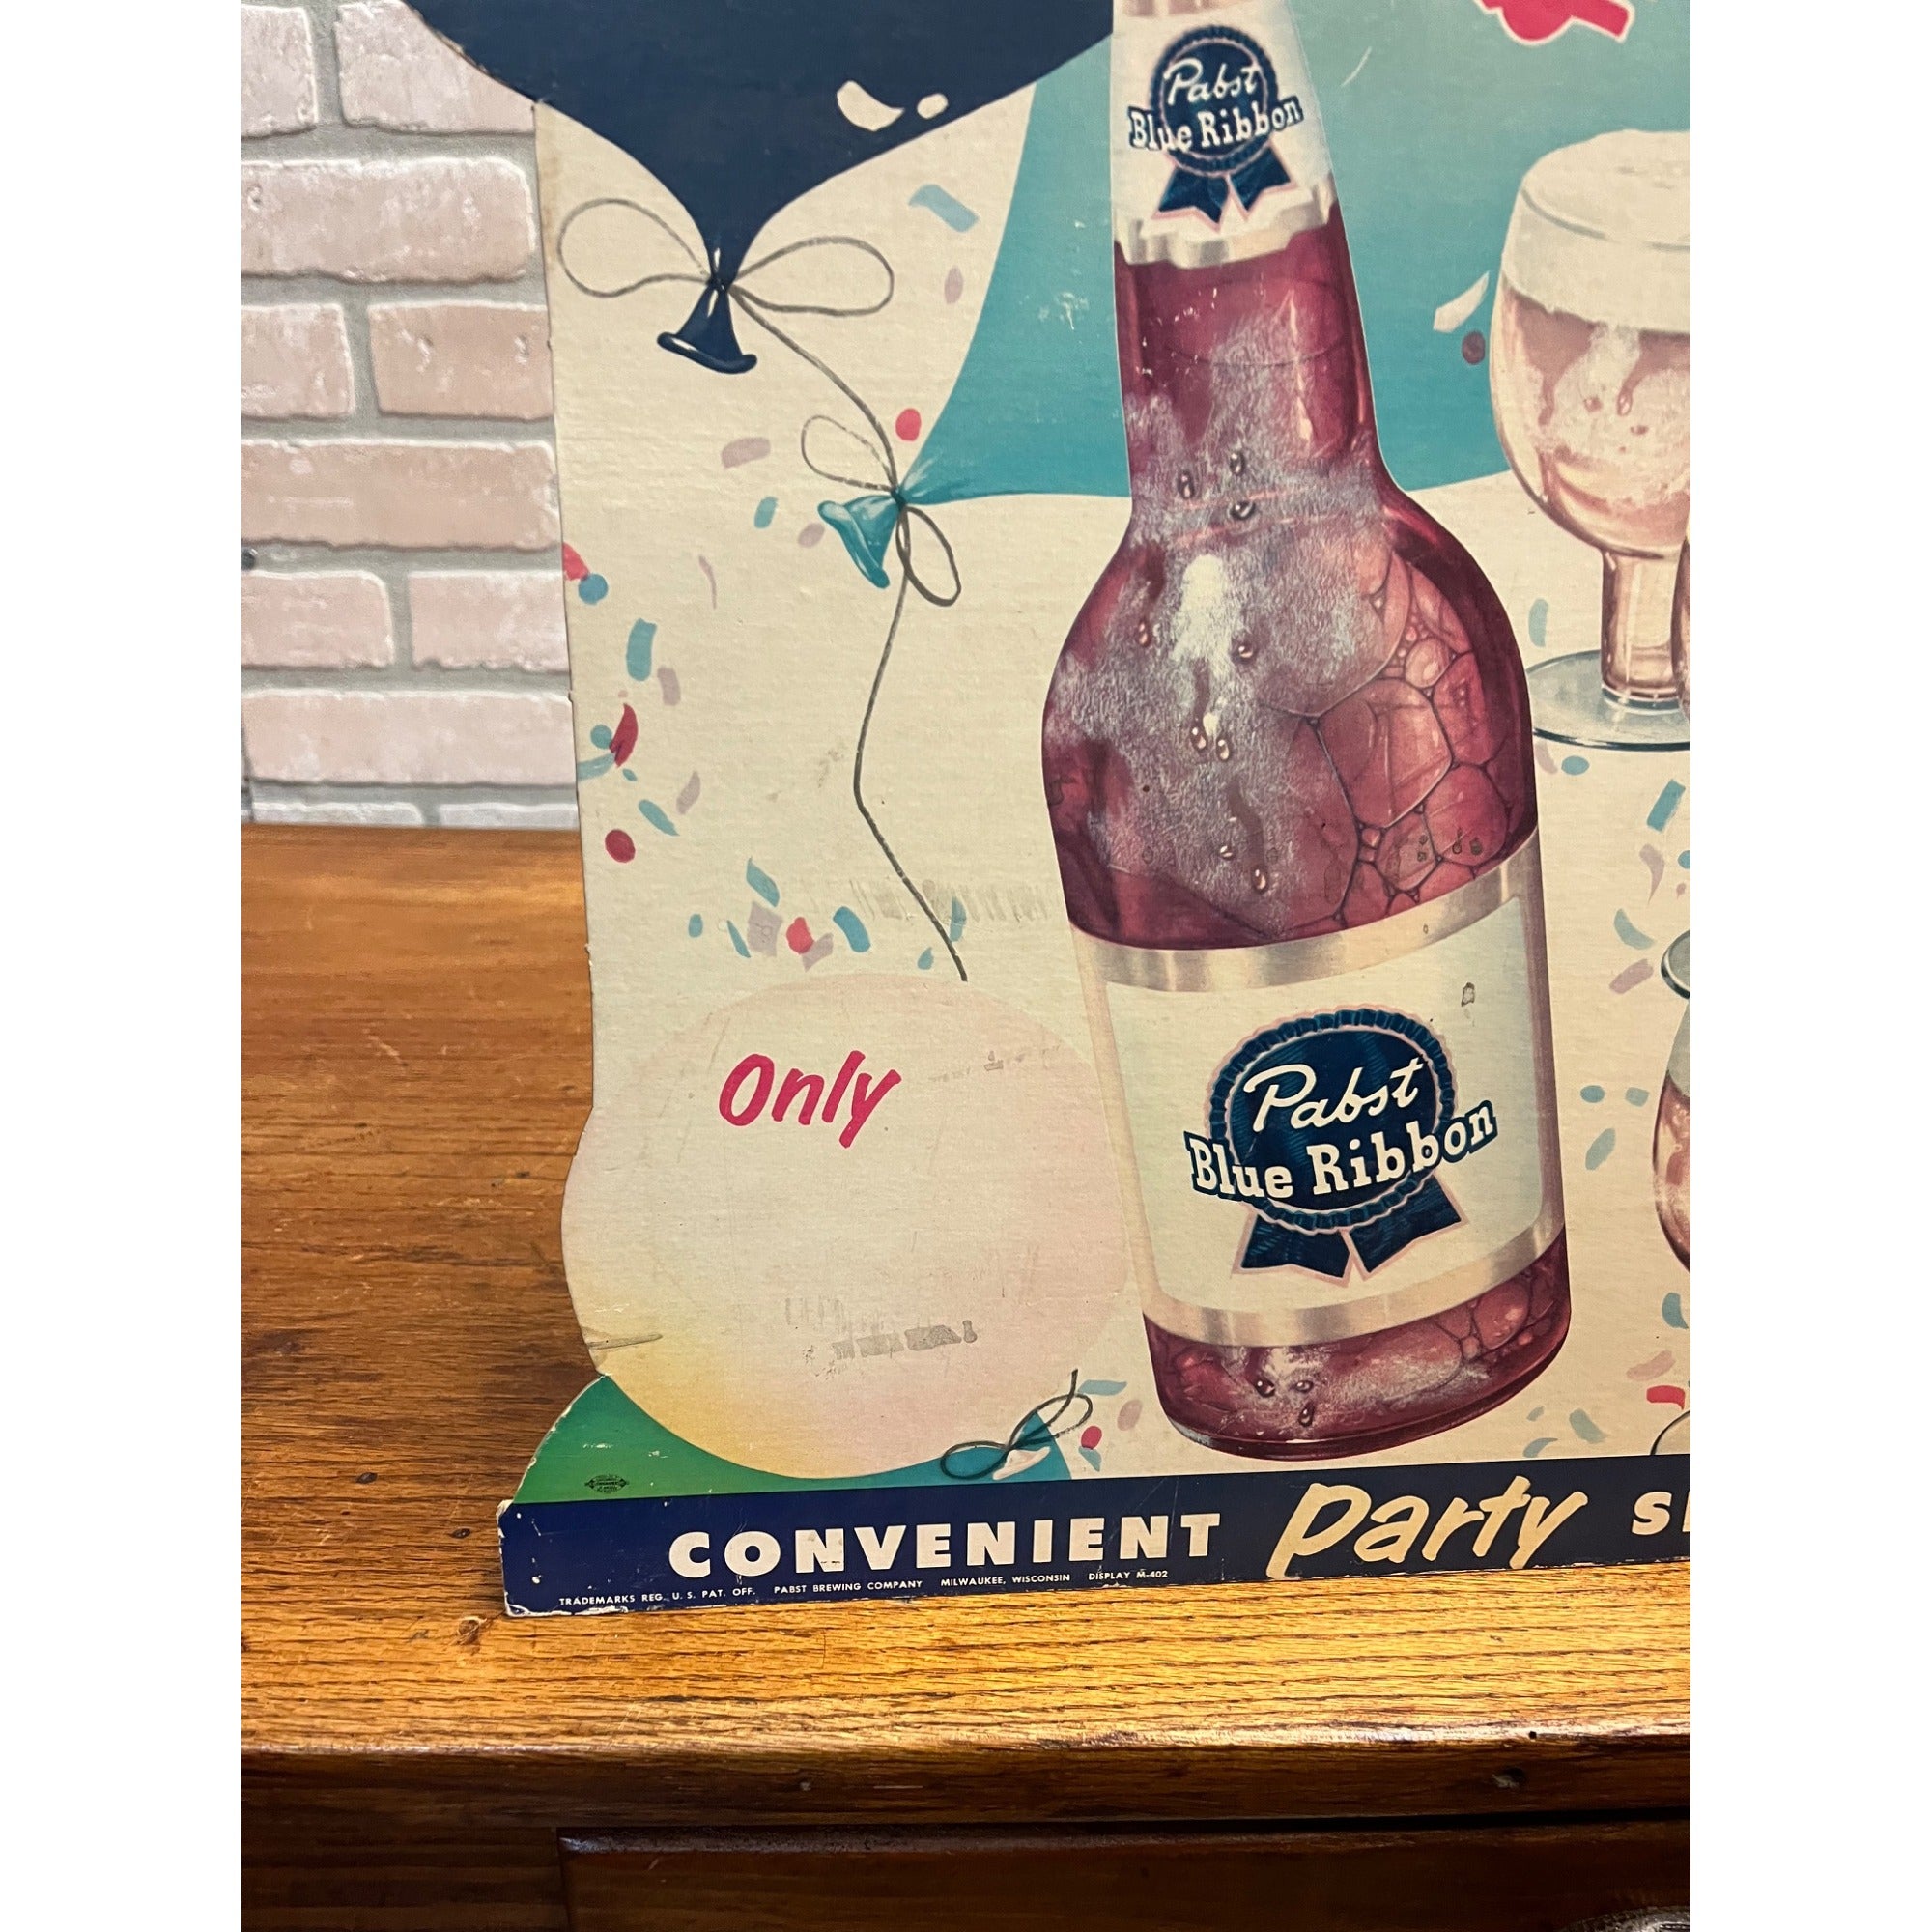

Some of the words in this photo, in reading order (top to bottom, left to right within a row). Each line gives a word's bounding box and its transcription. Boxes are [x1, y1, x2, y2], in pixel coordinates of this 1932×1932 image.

[1163, 57, 1261, 106] Pabst
[1130, 111, 1192, 153] Blue
[1197, 99, 1301, 148] Ribbon
[719, 1049, 902, 1149] Only
[1243, 1057, 1424, 1132] Pabst
[1190, 1137, 1293, 1199] Blue
[1306, 1104, 1494, 1195] Ribbon
[668, 1513, 1220, 1578] CONVENIENT
[1632, 1491, 1690, 1536] S
[559, 1595, 636, 1606] TRADEMARKS
[641, 1593, 664, 1603] REG.
[702, 1589, 726, 1598] PAT.
[733, 1587, 755, 1596] OFF.
[774, 1585, 807, 1594] PABST
[812, 1582, 862, 1593] BREWING
[867, 1580, 923, 1590] COMPANY
[941, 1577, 1007, 1586] MILWAUKEE,
[1012, 1574, 1070, 1584] WISCONSIN
[1089, 1572, 1130, 1581] DISPLAY
[1136, 1570, 1168, 1579] M-402
